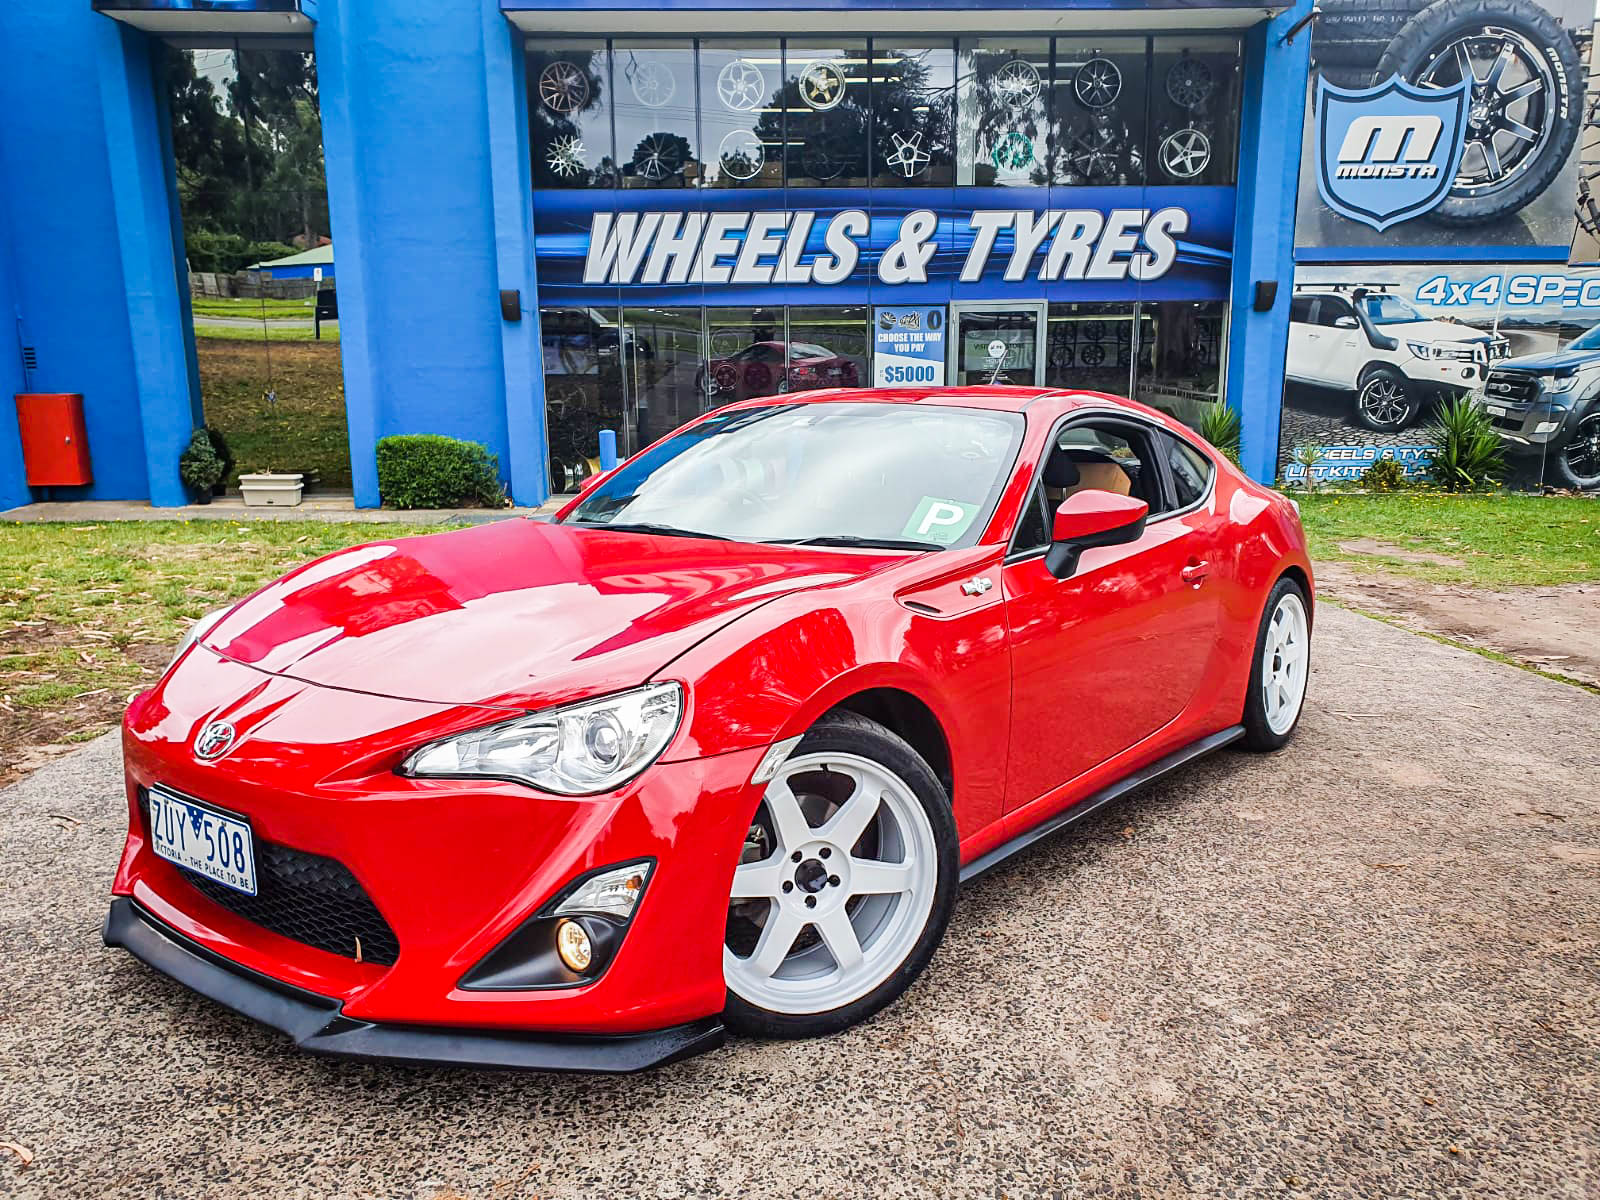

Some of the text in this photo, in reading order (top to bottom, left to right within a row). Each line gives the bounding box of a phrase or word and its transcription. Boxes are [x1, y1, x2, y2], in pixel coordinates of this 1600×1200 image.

[1335, 164, 1438, 179] MONSTA
[583, 207, 1189, 285] WHEELS & TYRES
[1417, 276, 1500, 304] 4x4
[878, 333, 942, 343] CHOOSE THE WAY
[894, 343, 925, 353] YOU PAY
[885, 364, 935, 384] $5000
[917, 502, 964, 535] P
[152, 799, 245, 873] ZUY 508
[155, 840, 181, 861] CTORIA
[189, 856, 202, 870] THE
[204, 863, 224, 880] PLACE
[226, 871, 237, 884] TO
[239, 877, 249, 889] BE
